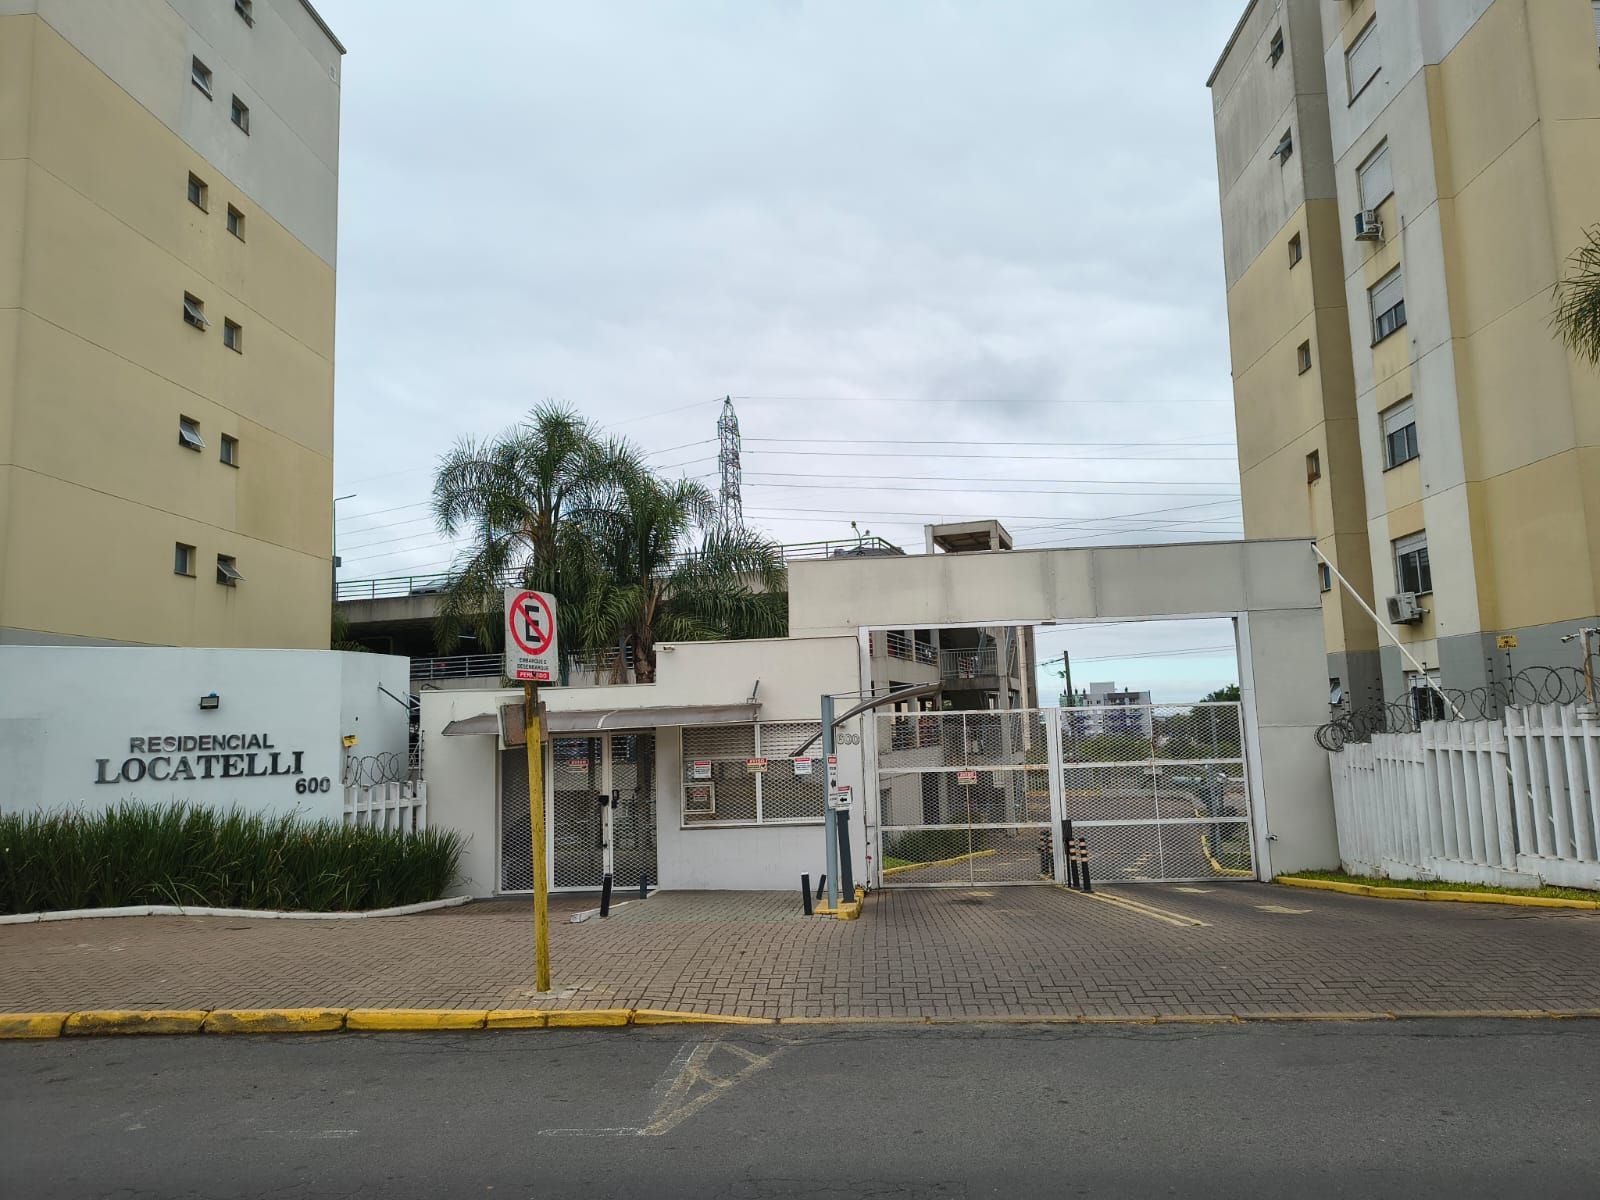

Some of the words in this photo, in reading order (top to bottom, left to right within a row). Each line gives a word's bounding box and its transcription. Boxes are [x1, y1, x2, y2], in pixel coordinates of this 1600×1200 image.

[524, 604, 542, 643] E
[129, 733, 275, 754] RESIDENCIAL
[837, 733, 861, 746] 600
[94, 751, 305, 785] LOCATELLI
[295, 777, 331, 795] 600
